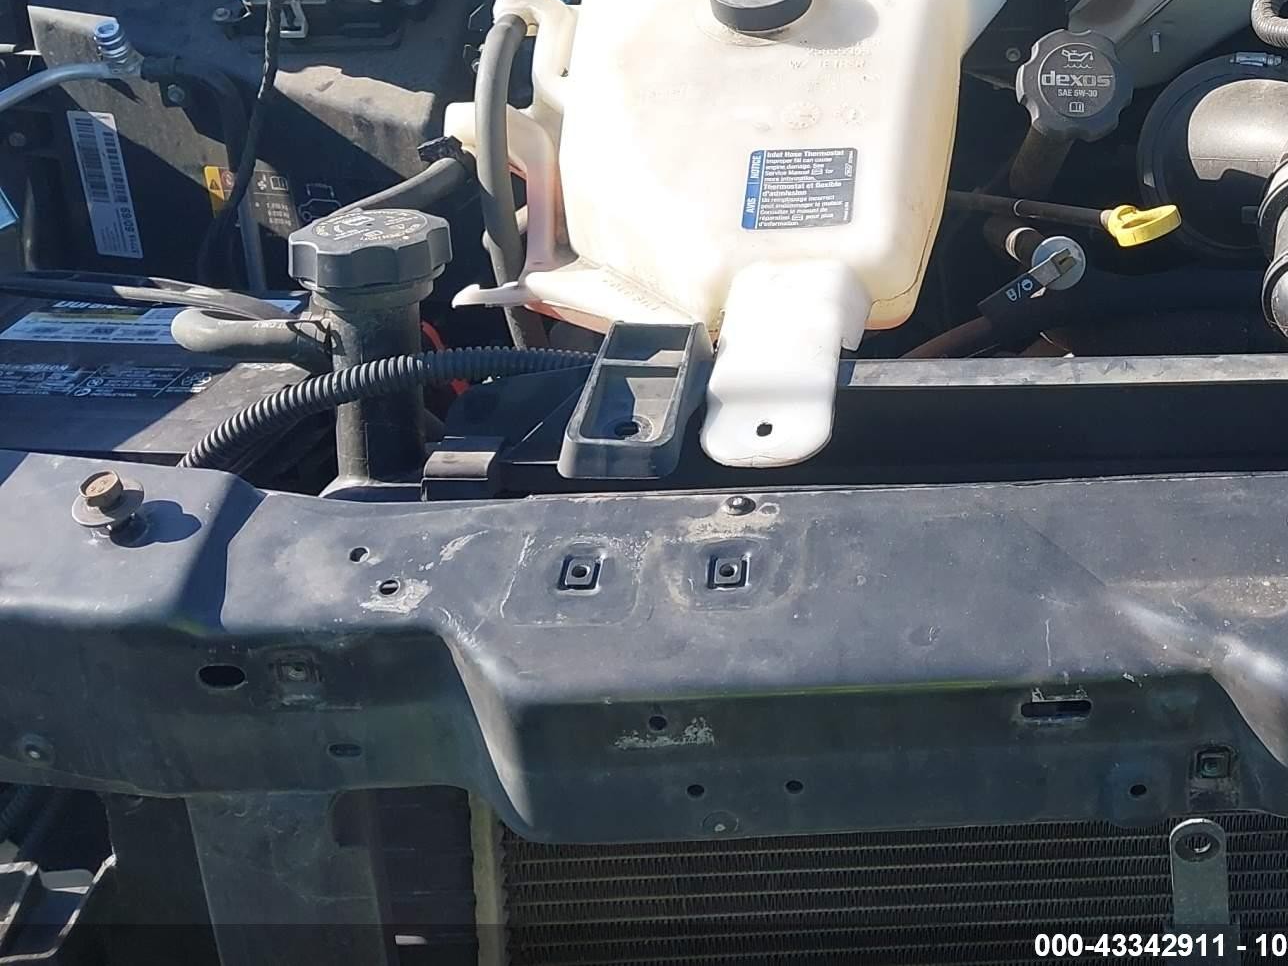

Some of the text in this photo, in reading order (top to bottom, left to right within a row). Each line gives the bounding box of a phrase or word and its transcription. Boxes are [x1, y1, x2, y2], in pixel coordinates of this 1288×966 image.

[1041, 70, 1113, 87] dexos
[1057, 89, 1098, 98] SAE 5W-30
[749, 155, 762, 179] NOTICE
[745, 197, 757, 214] AVIS
